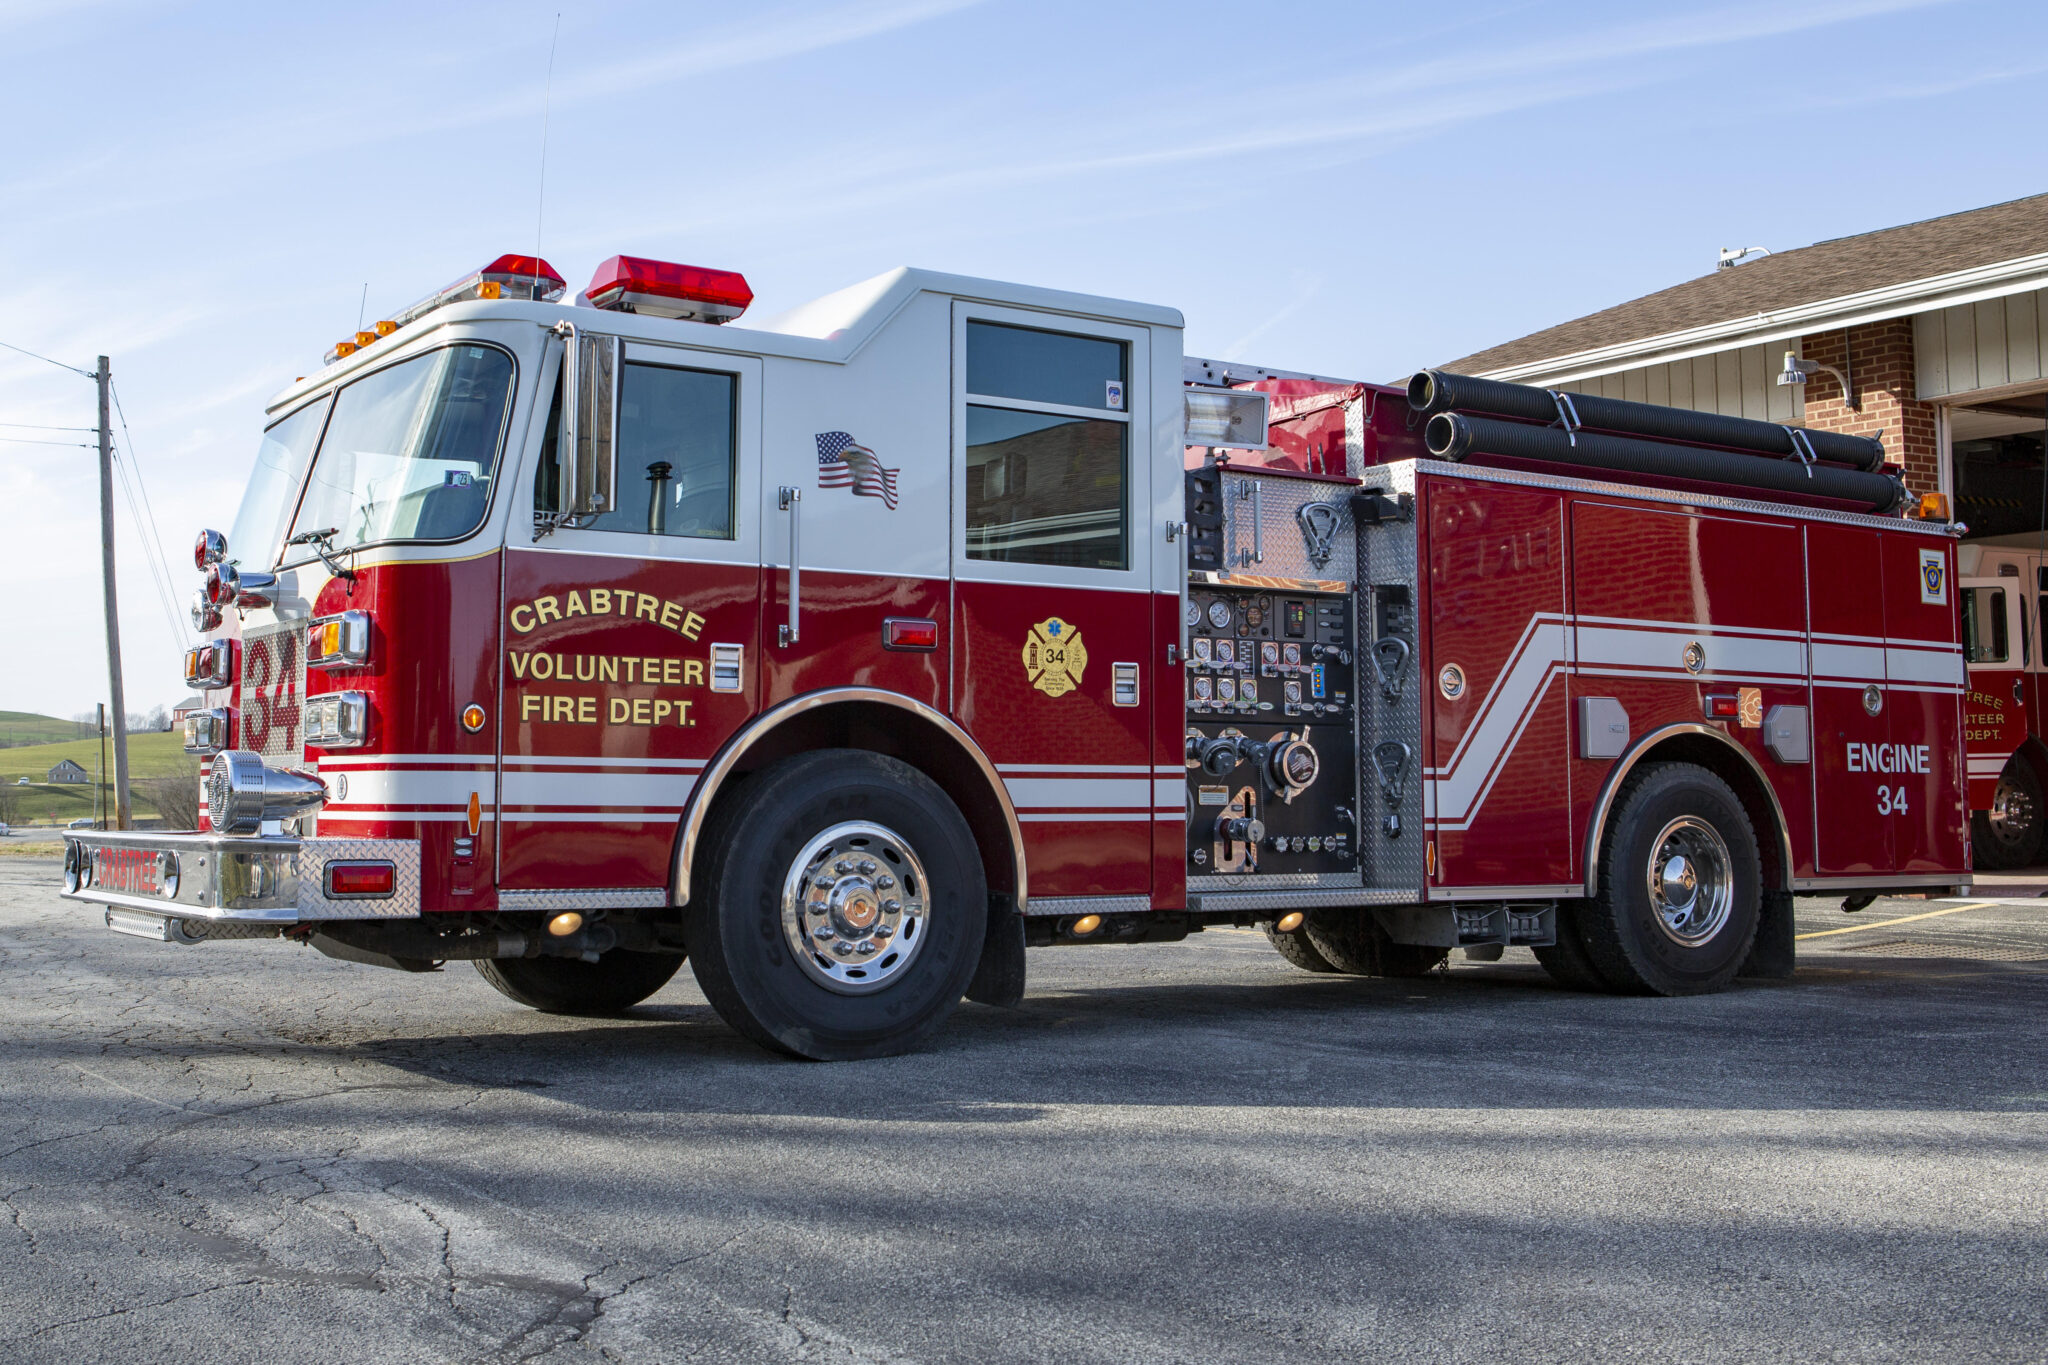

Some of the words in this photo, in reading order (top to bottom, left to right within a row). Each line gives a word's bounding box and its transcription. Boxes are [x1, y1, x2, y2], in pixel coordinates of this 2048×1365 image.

[460, 473, 468, 485] 23
[510, 588, 706, 642] CRABTREE
[508, 651, 705, 686] VOLUNTEER
[1046, 649, 1065, 663] 34
[245, 631, 300, 753] 34
[521, 694, 597, 724] FIRE
[609, 697, 696, 727] DEPT.
[1966, 729, 2002, 741] DEPT.
[1847, 742, 1931, 773] ENGINE
[1877, 785, 1908, 816] 34
[99, 846, 157, 893] CRABTREE
